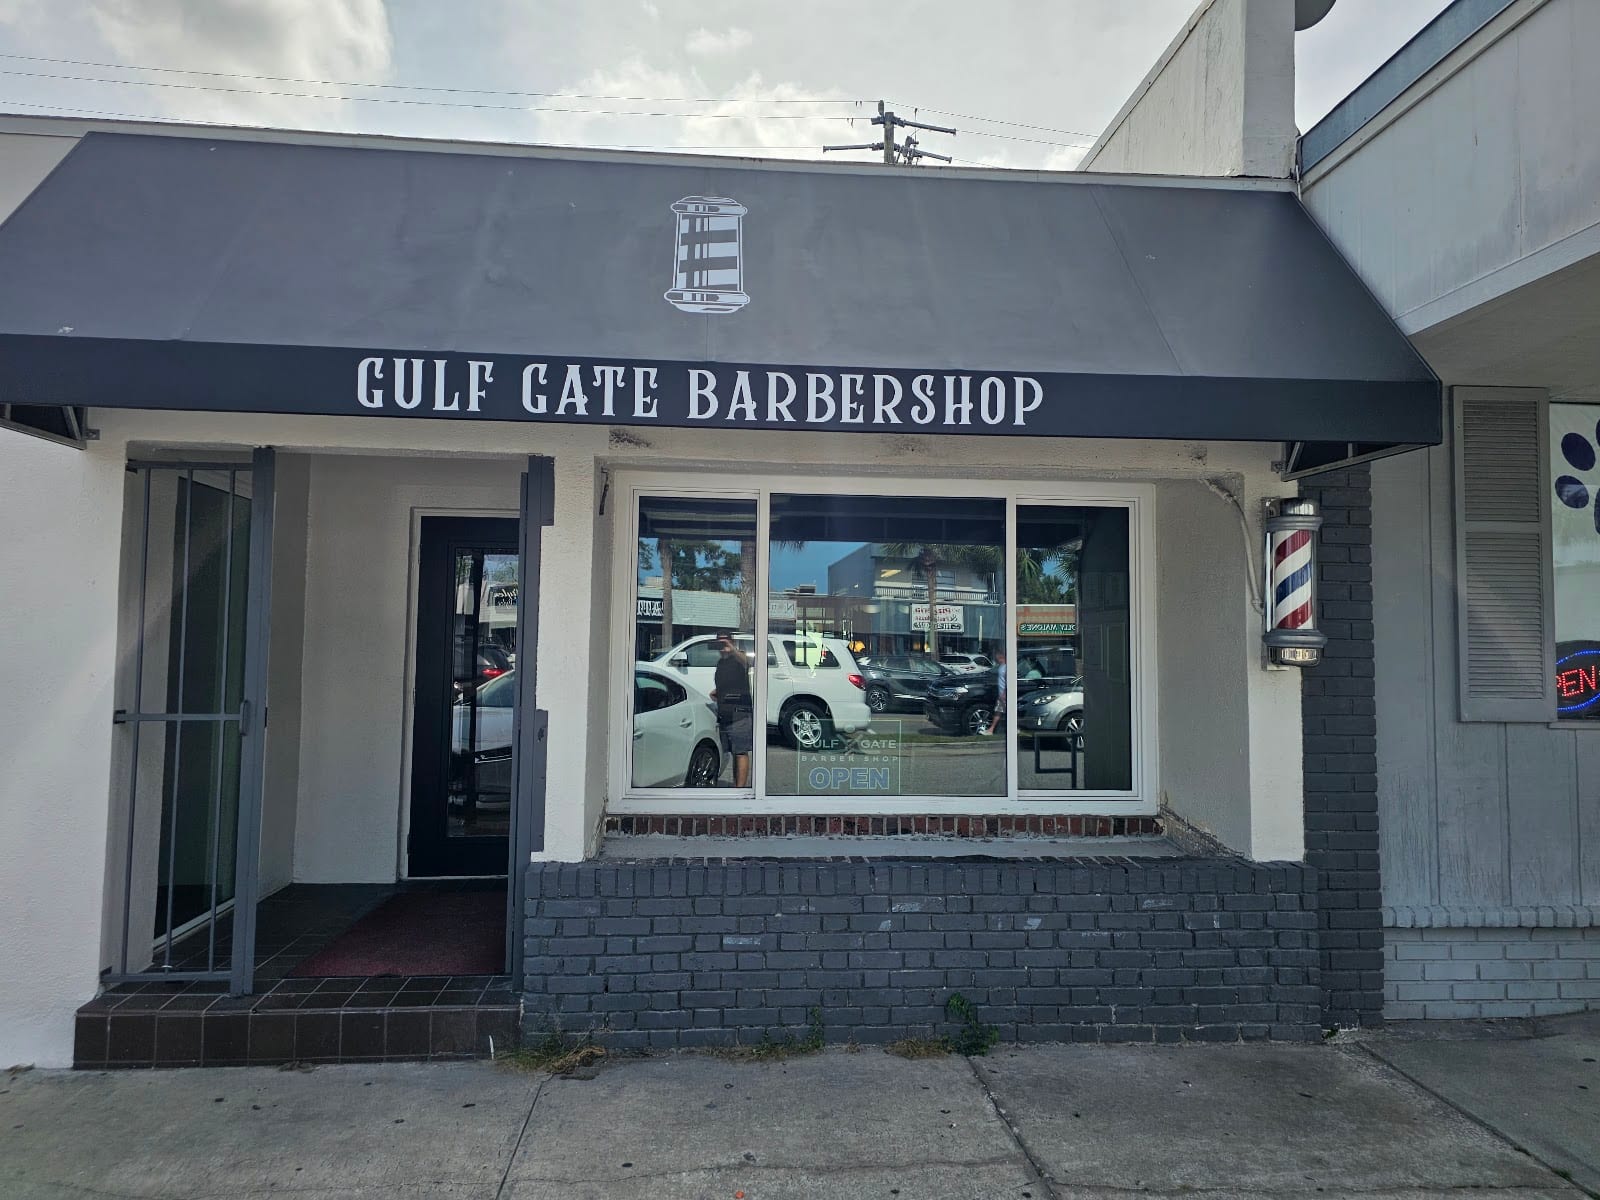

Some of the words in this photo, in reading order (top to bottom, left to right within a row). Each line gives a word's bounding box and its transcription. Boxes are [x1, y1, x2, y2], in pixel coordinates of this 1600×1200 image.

[357, 357, 494, 412] GULF
[522, 363, 658, 418] GATE
[687, 370, 1044, 426] BARBERSHOP
[860, 739, 897, 749] GATE
[808, 766, 890, 790] OPEN
